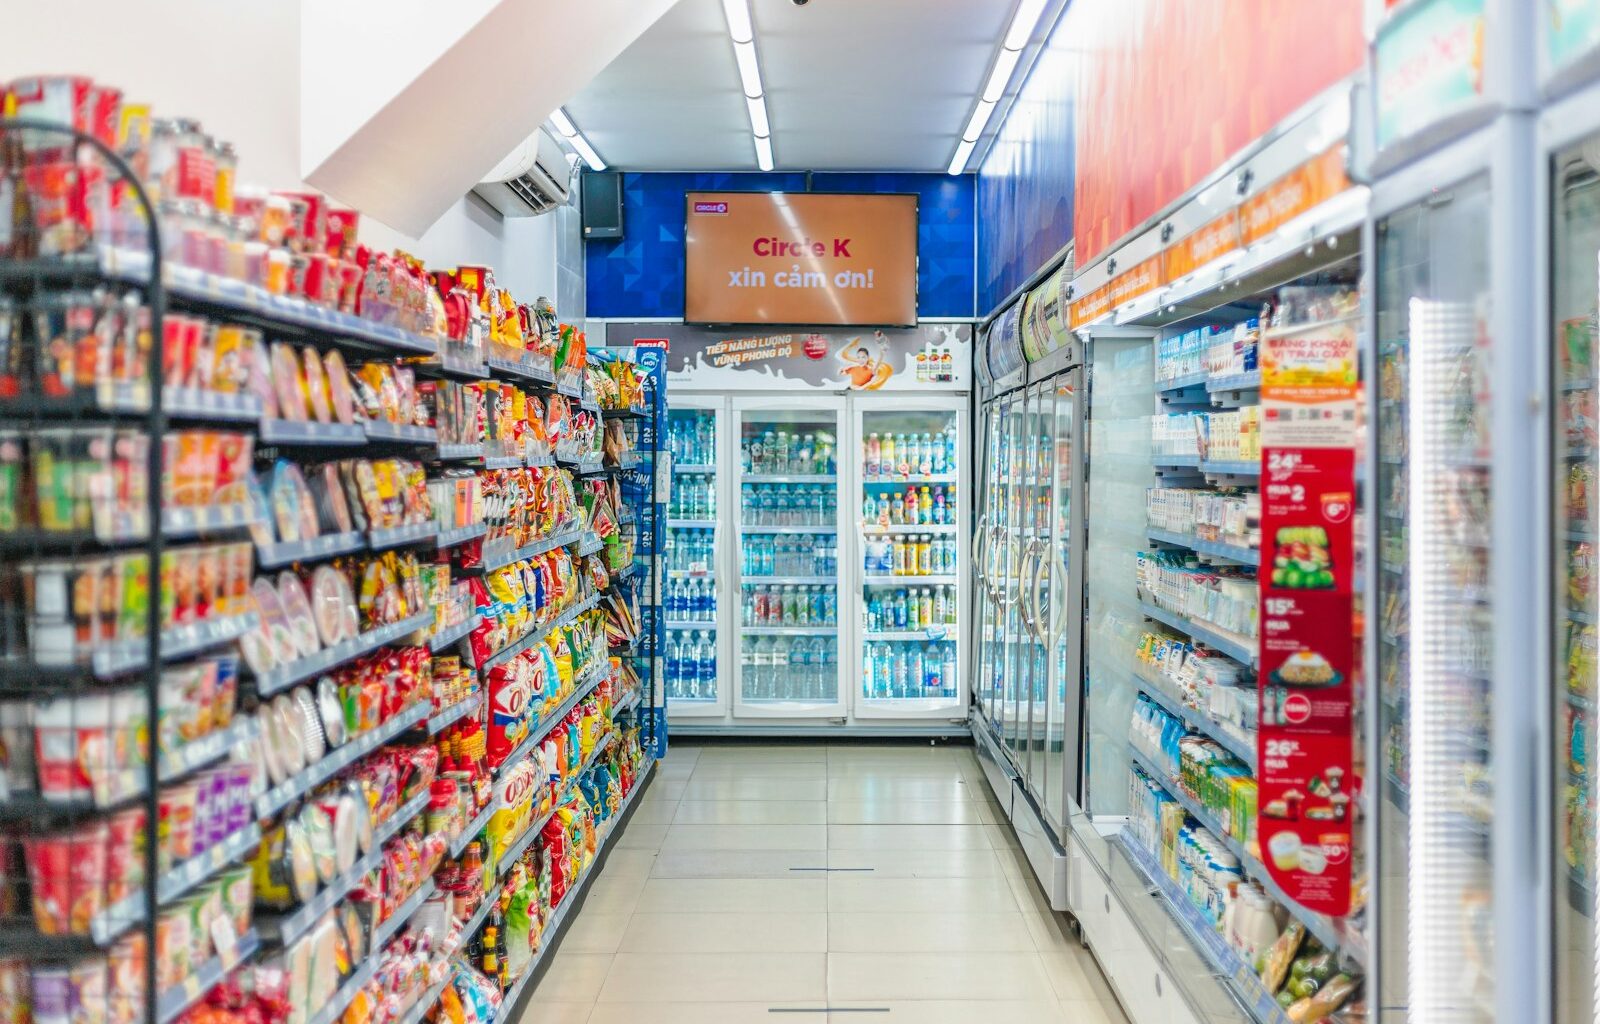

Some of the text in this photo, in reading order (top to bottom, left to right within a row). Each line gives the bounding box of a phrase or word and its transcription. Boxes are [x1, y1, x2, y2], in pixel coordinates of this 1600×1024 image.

[753, 237, 851, 257] Circle K
[728, 264, 874, 288] xin cảm ơn!
[729, 336, 757, 351] NĂNG
[742, 349, 776, 361] PHONG
[1291, 484, 1305, 501] 2
